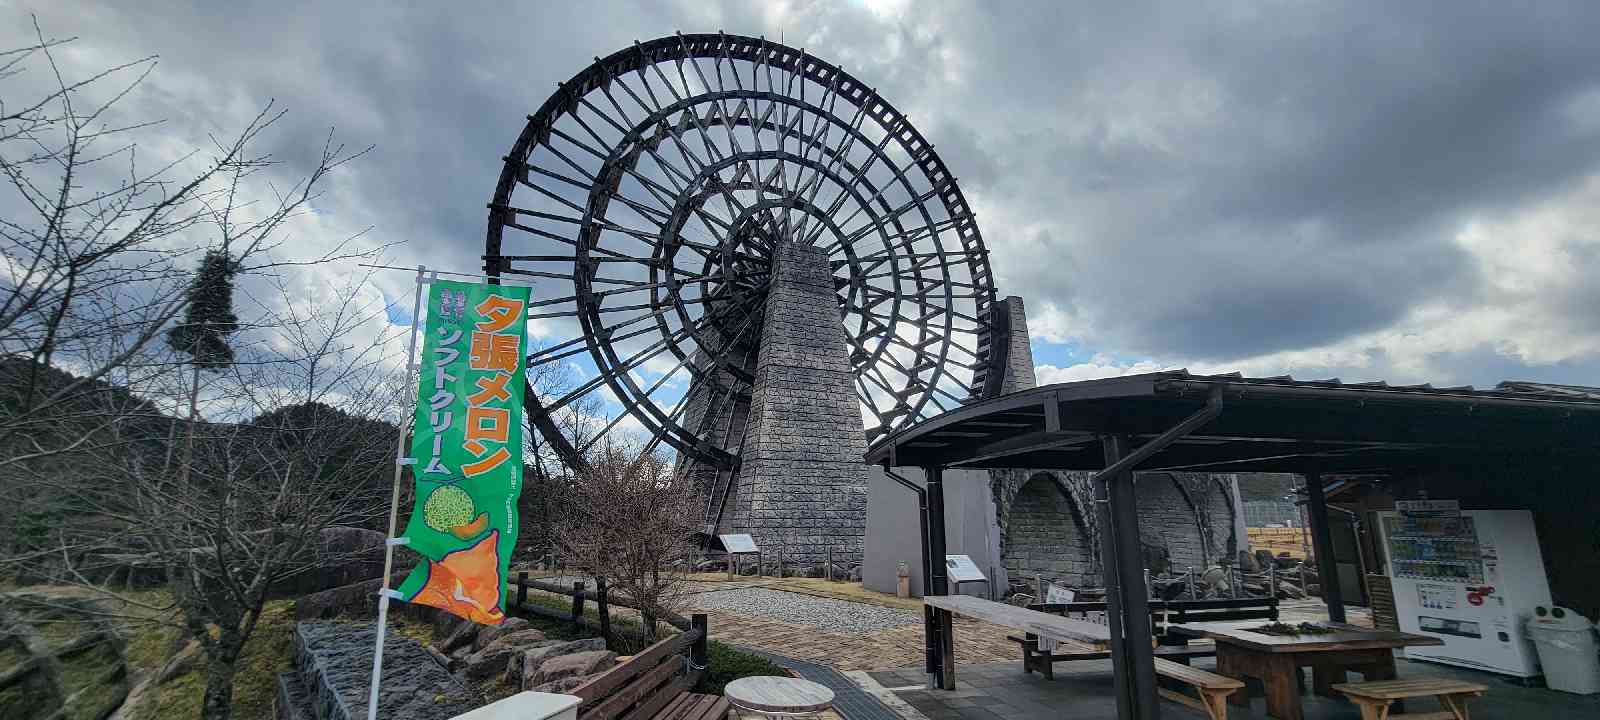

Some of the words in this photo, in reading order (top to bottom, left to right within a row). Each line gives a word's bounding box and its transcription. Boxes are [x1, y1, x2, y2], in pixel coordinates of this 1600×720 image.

[424, 327, 464, 475] ソフトクリーム
[461, 294, 524, 477] 夕張メロン
